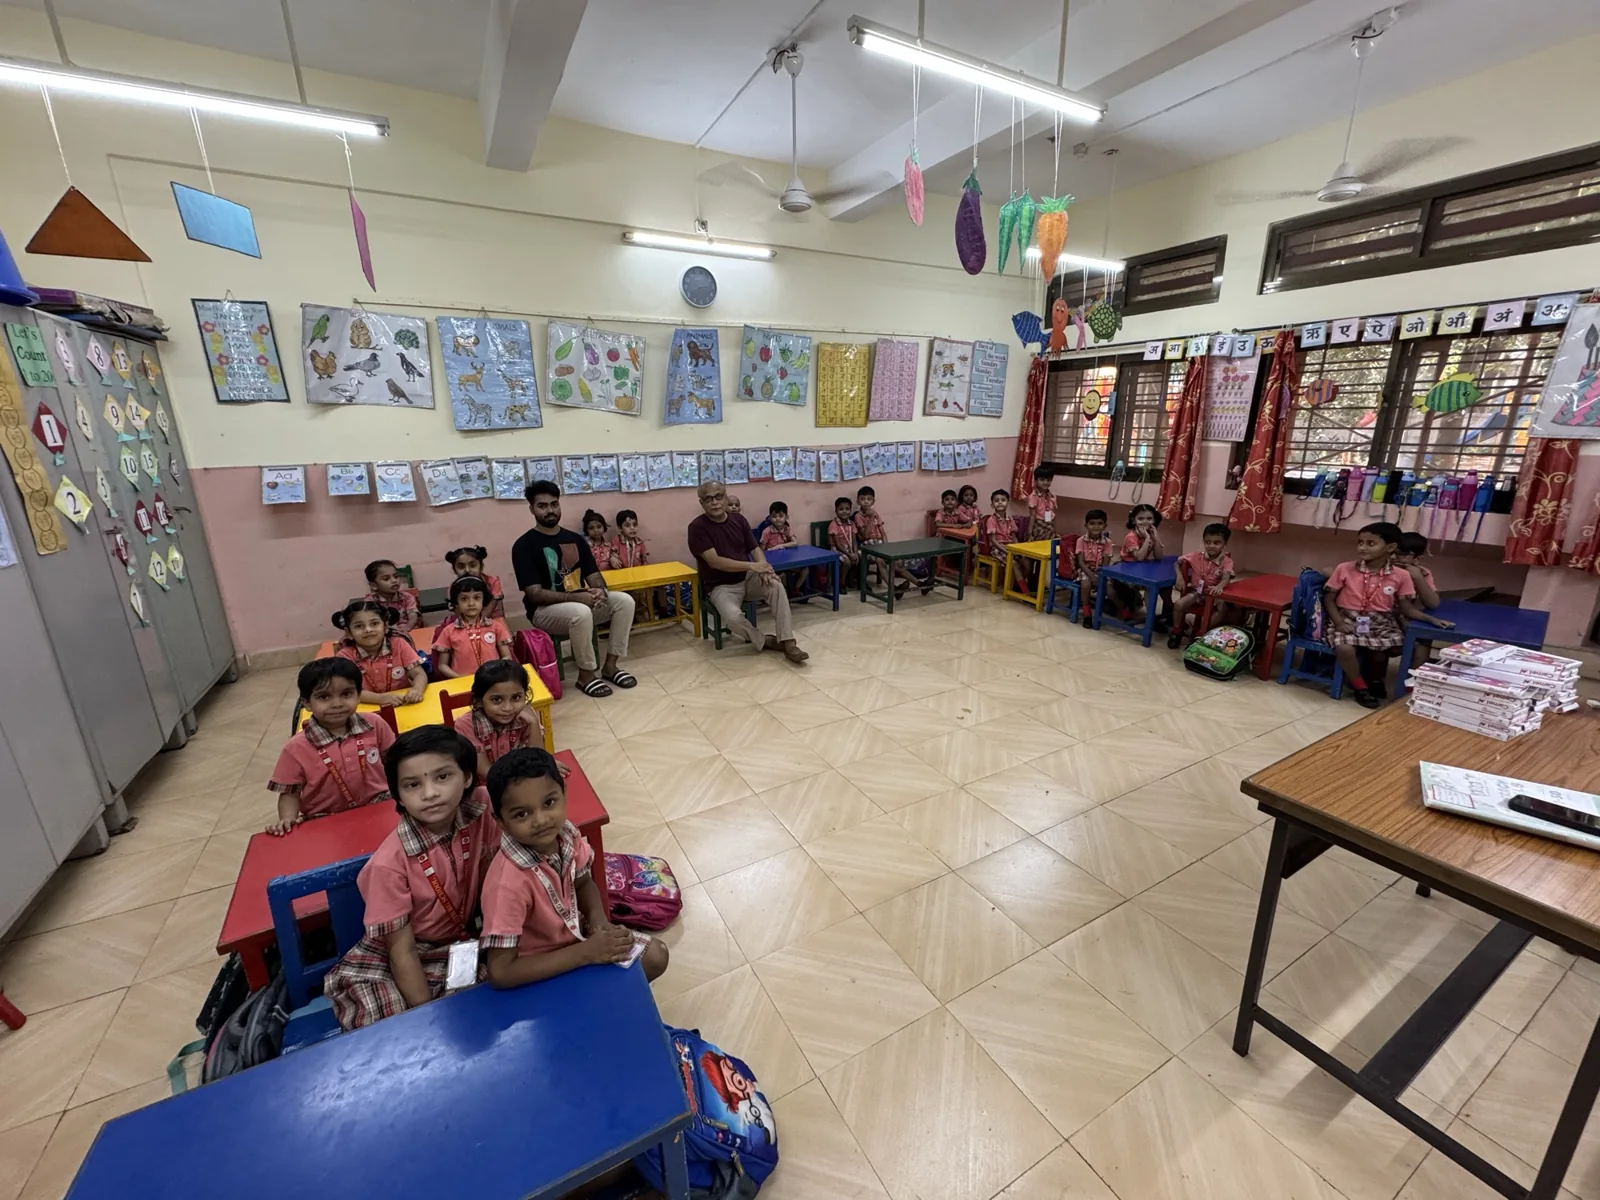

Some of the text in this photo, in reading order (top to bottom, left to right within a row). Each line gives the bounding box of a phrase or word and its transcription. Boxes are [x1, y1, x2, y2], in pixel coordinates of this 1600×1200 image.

[1445, 312, 1467, 327] औ
[1493, 308, 1513, 322] अं
[12, 324, 38, 340] Let's
[1339, 324, 1351, 337] ए
[1371, 320, 1386, 337] ऐ
[1406, 318, 1425, 332] ओ
[1306, 327, 1321, 340] ऋ
[1150, 346, 1158, 354] अ
[1168, 344, 1180, 352] आ
[1218, 338, 1226, 352] ई
[1238, 340, 1248, 351] उ
[16, 346, 46, 362] Count
[94, 346, 104, 367] 8
[116, 353, 127, 370] 13
[30, 370, 40, 381] to
[41, 370, 52, 382] 20
[110, 406, 118, 425] 9
[129, 405, 142, 420] 14
[46, 420, 57, 443] 1
[124, 458, 136, 474] 10
[143, 454, 154, 469] 15
[465, 464, 478, 472] Ee
[536, 463, 548, 472] Gg
[432, 469, 446, 478] Dd
[66, 492, 81, 514] 2
[139, 512, 150, 528] 11
[158, 504, 168, 522] 16
[153, 561, 164, 577] 12
[431, 878, 446, 903] SCHOOL
[547, 884, 558, 904] SCHOOL
[556, 904, 564, 913] KG
